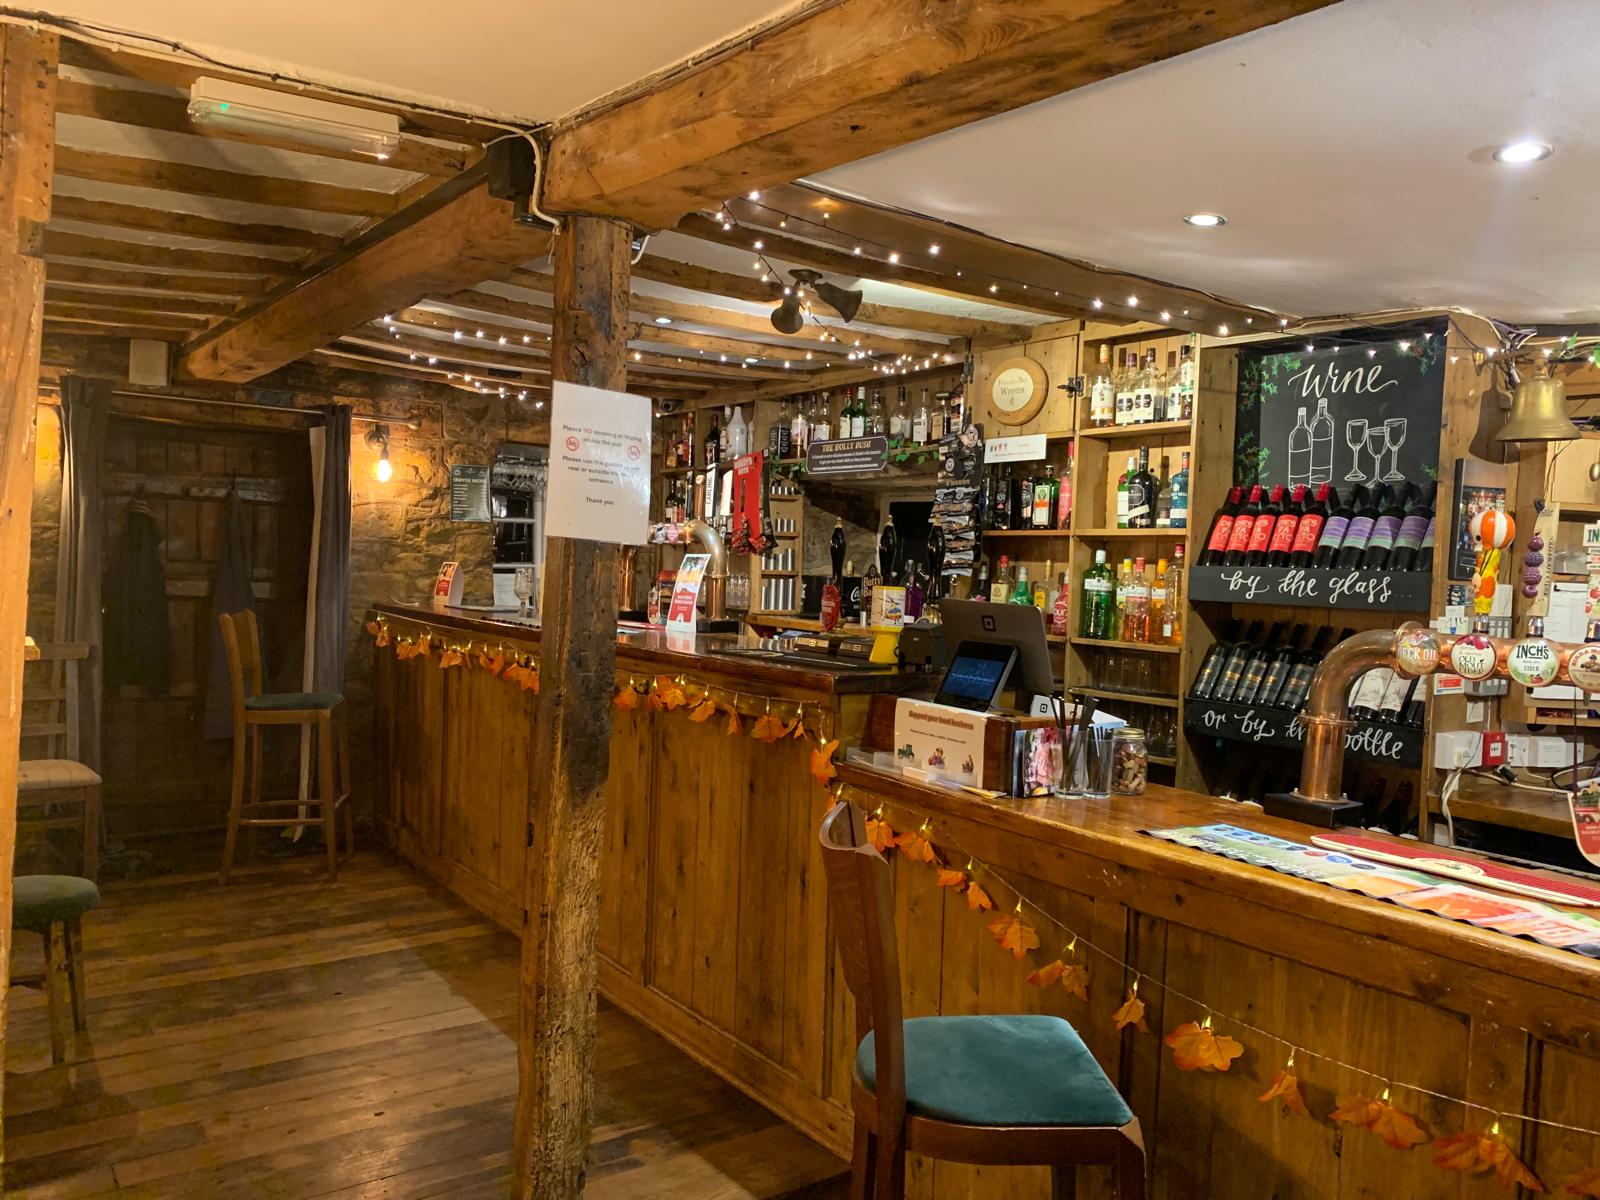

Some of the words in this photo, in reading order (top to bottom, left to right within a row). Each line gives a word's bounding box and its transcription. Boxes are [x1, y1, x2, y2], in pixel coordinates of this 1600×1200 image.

[1288, 361, 1398, 398] Wine
[822, 443, 833, 453] THE
[834, 441, 854, 452] HOLLY
[855, 440, 872, 449] BUSH
[1221, 570, 1269, 599] by
[1278, 570, 1318, 597] the
[1459, 655, 1476, 664] OLD
[1202, 710, 1225, 729] or
[1234, 709, 1275, 742] by
